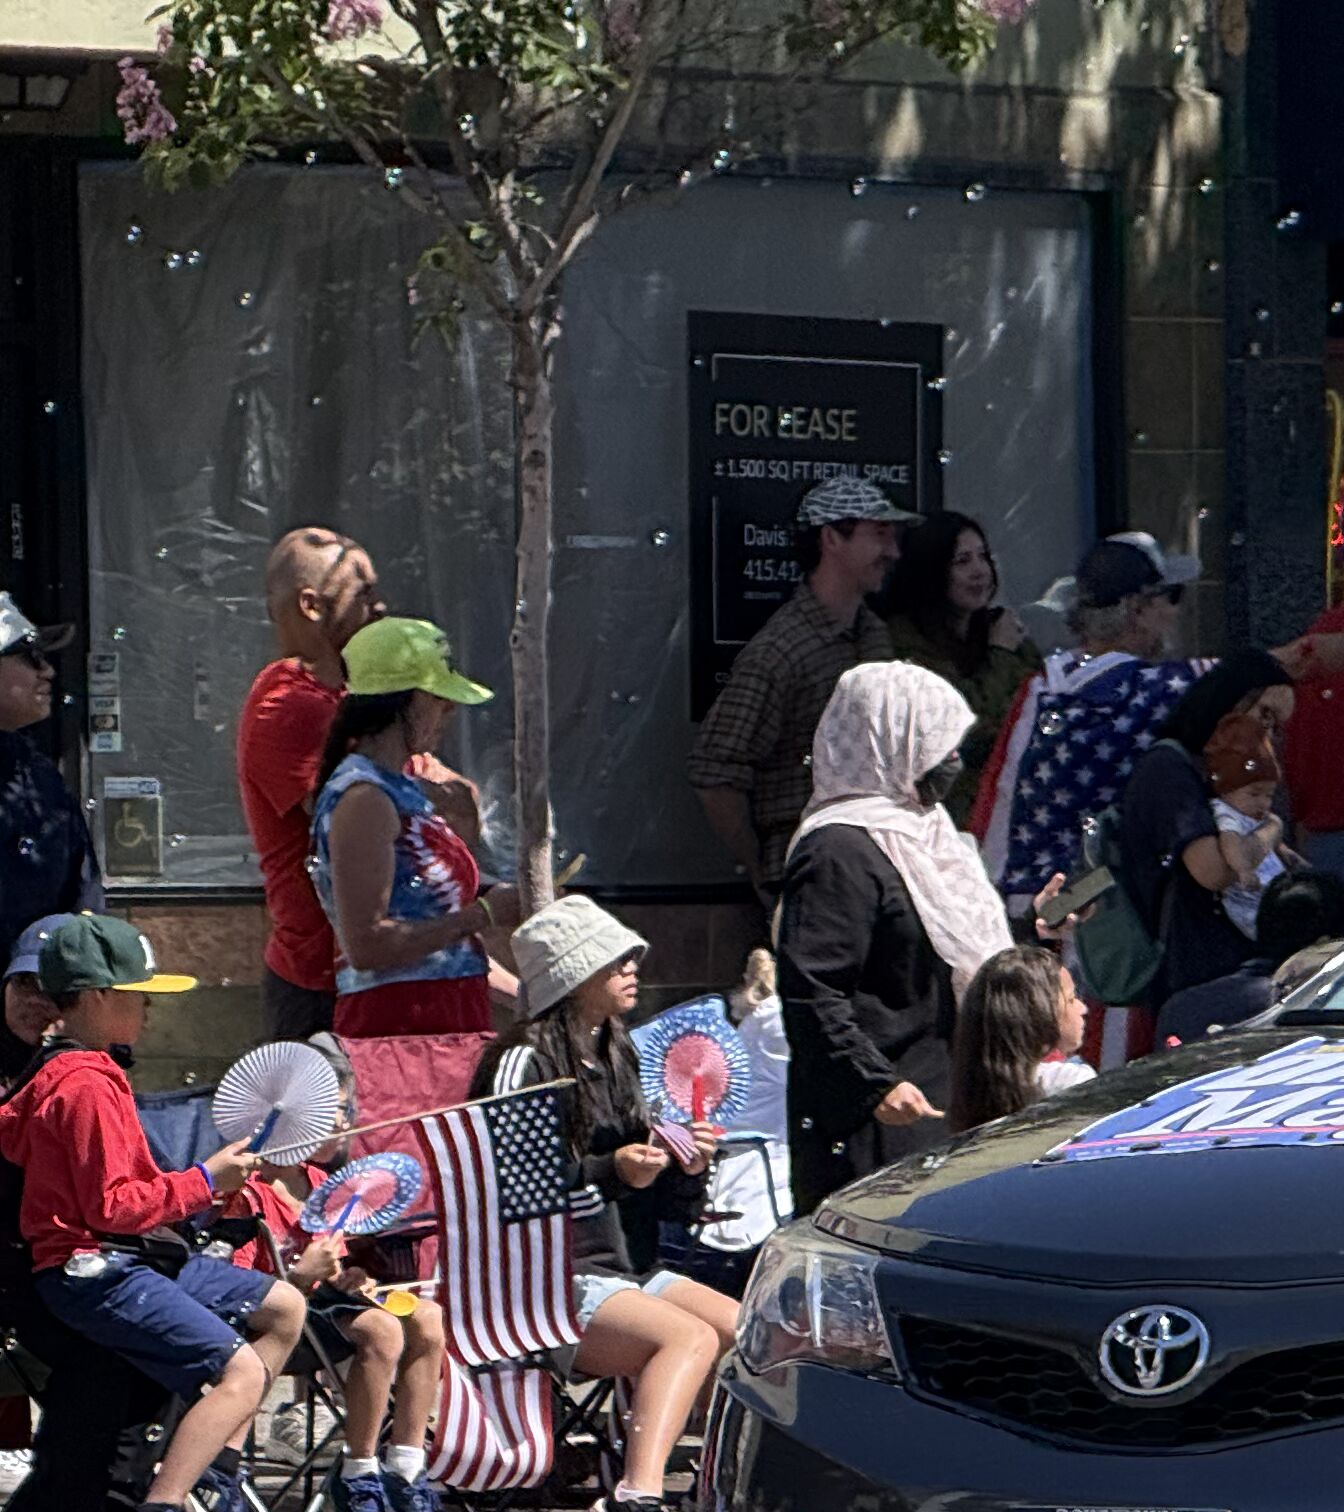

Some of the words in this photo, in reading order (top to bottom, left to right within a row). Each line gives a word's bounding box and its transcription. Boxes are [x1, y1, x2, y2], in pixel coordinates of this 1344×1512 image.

[714, 402, 770, 438] FOR
[777, 405, 859, 441] LEASE
[768, 459, 790, 482] SQ
[793, 461, 811, 480] FT
[813, 462, 860, 481] RETAIL
[863, 464, 910, 484] SPACE
[743, 523, 786, 547] Davis
